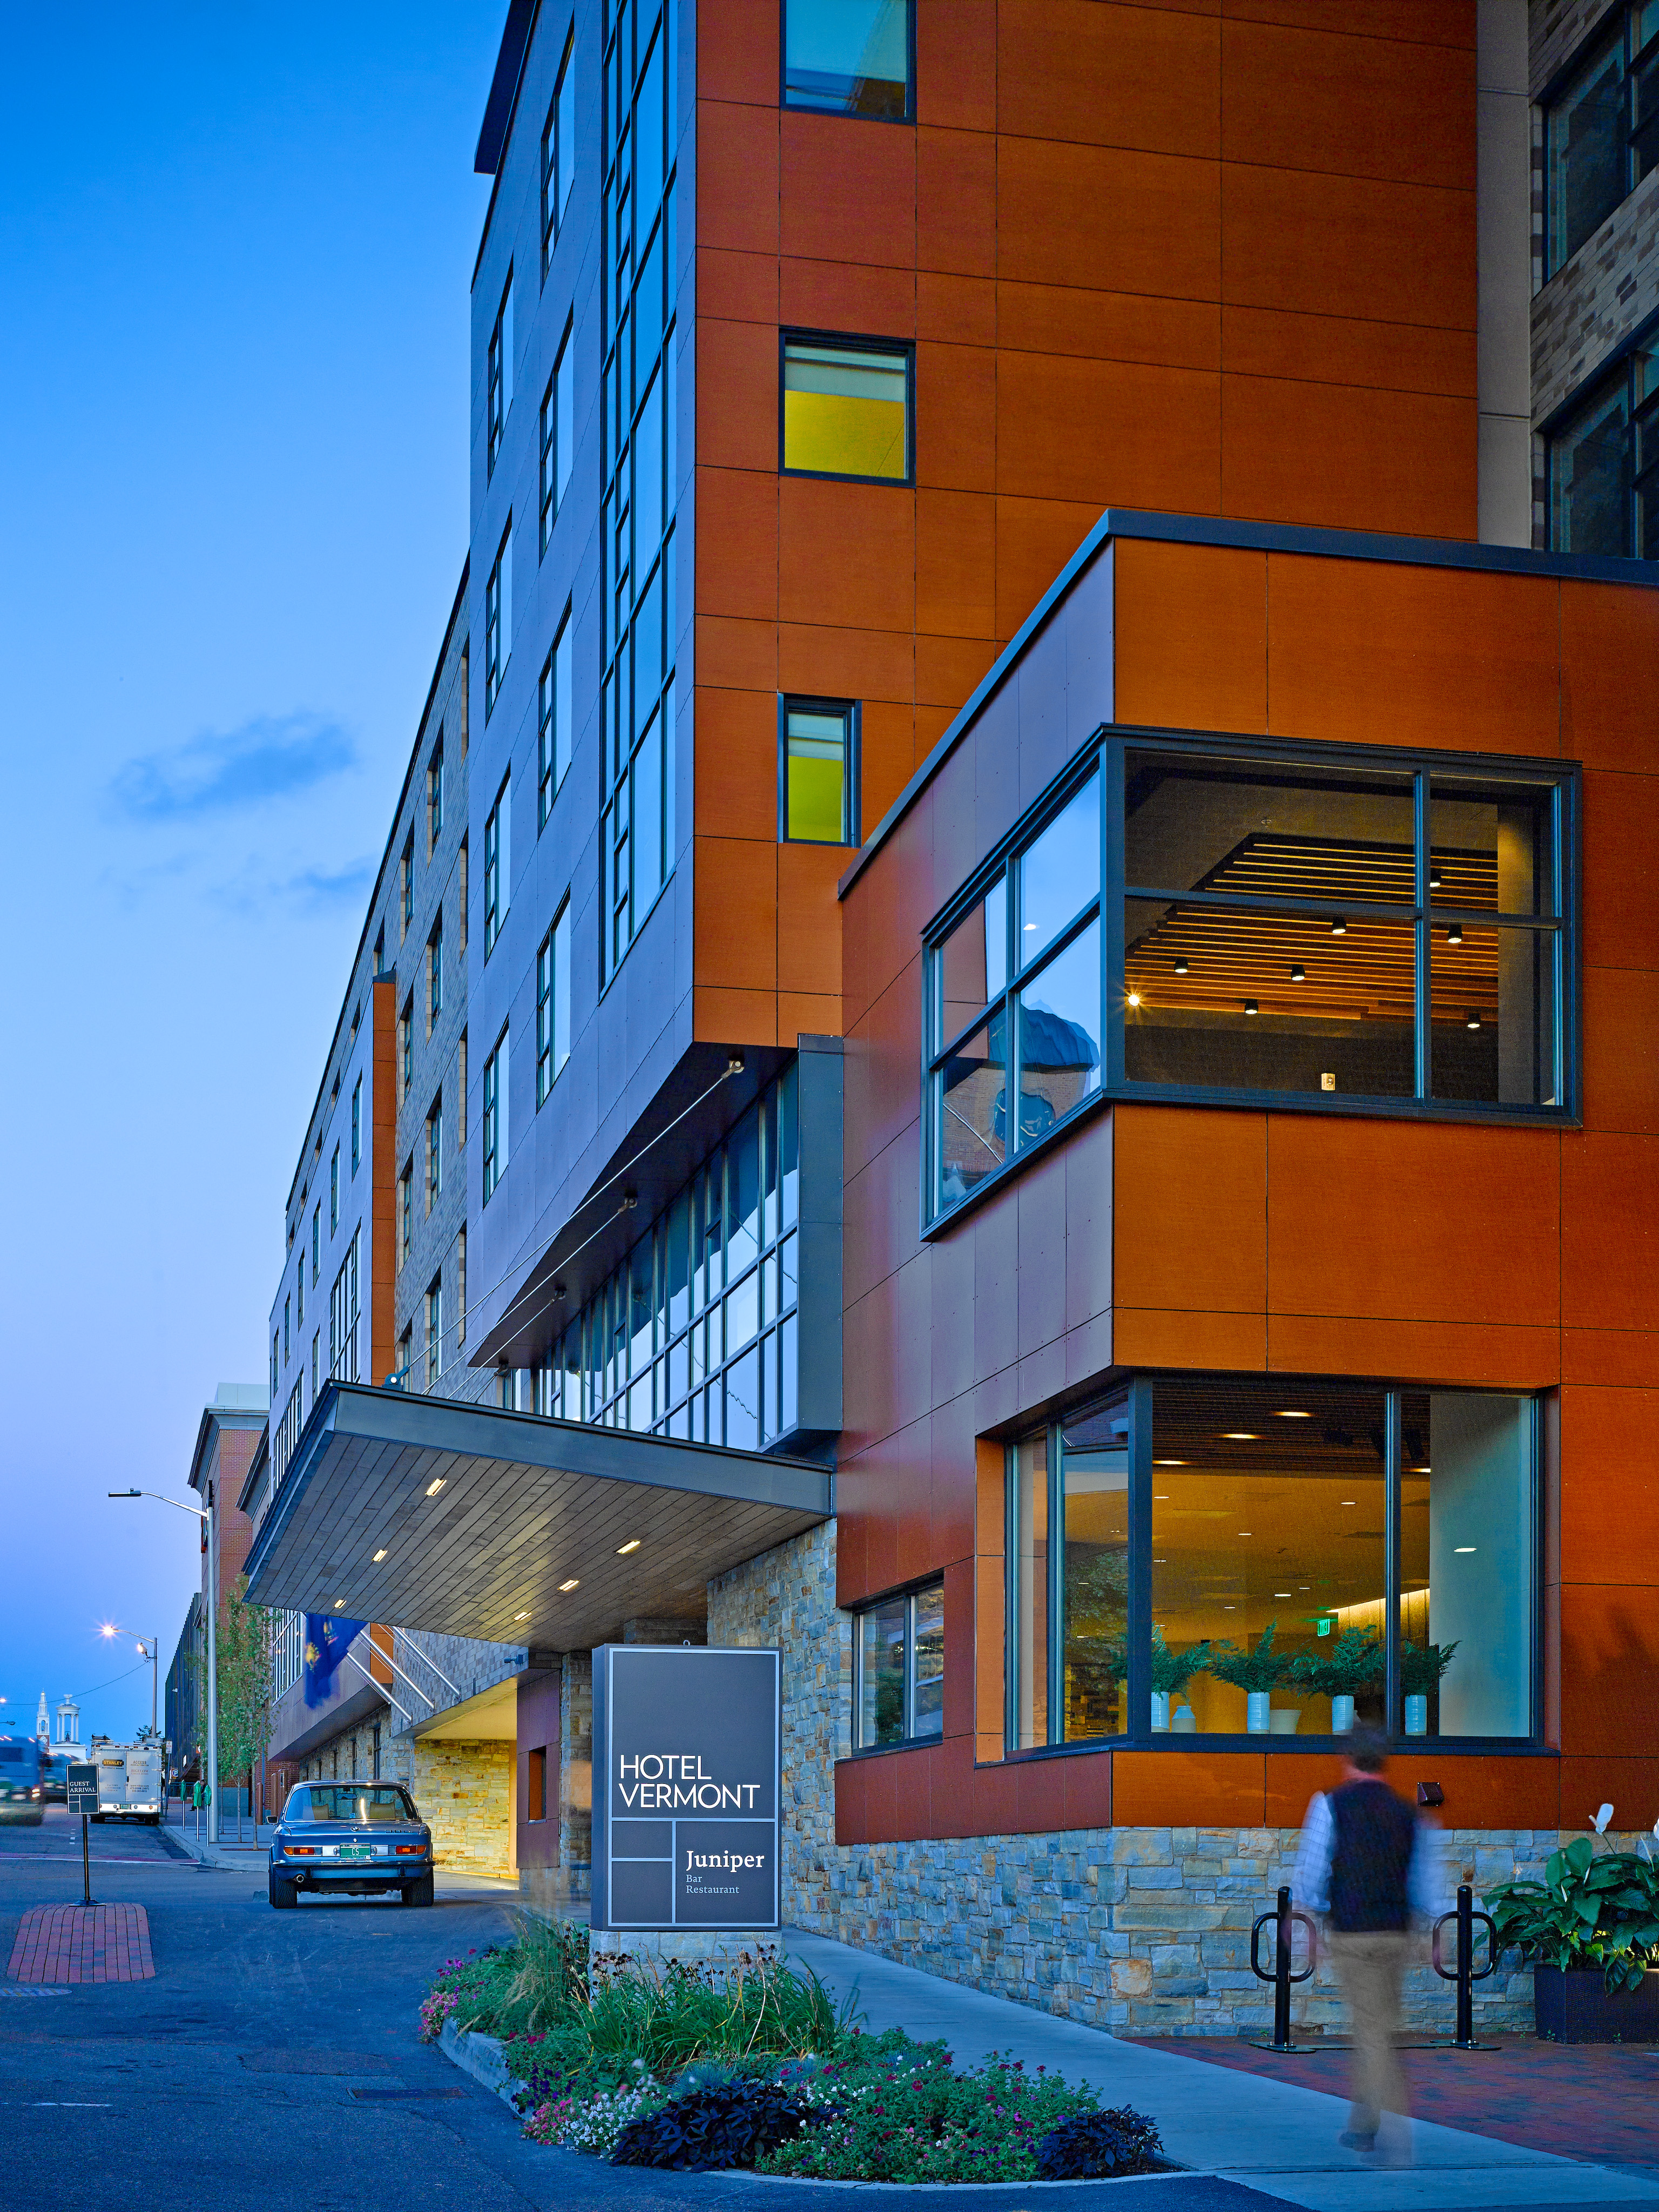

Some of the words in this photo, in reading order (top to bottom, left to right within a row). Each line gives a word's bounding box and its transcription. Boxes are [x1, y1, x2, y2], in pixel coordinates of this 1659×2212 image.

[620, 1754, 712, 1779] HOTEL
[618, 1783, 760, 1809] VERMONT
[352, 1847, 360, 1856] CS
[685, 1850, 765, 1873] Juniper
[685, 1874, 703, 1883] Bar
[685, 1885, 740, 1894] Restaurant
